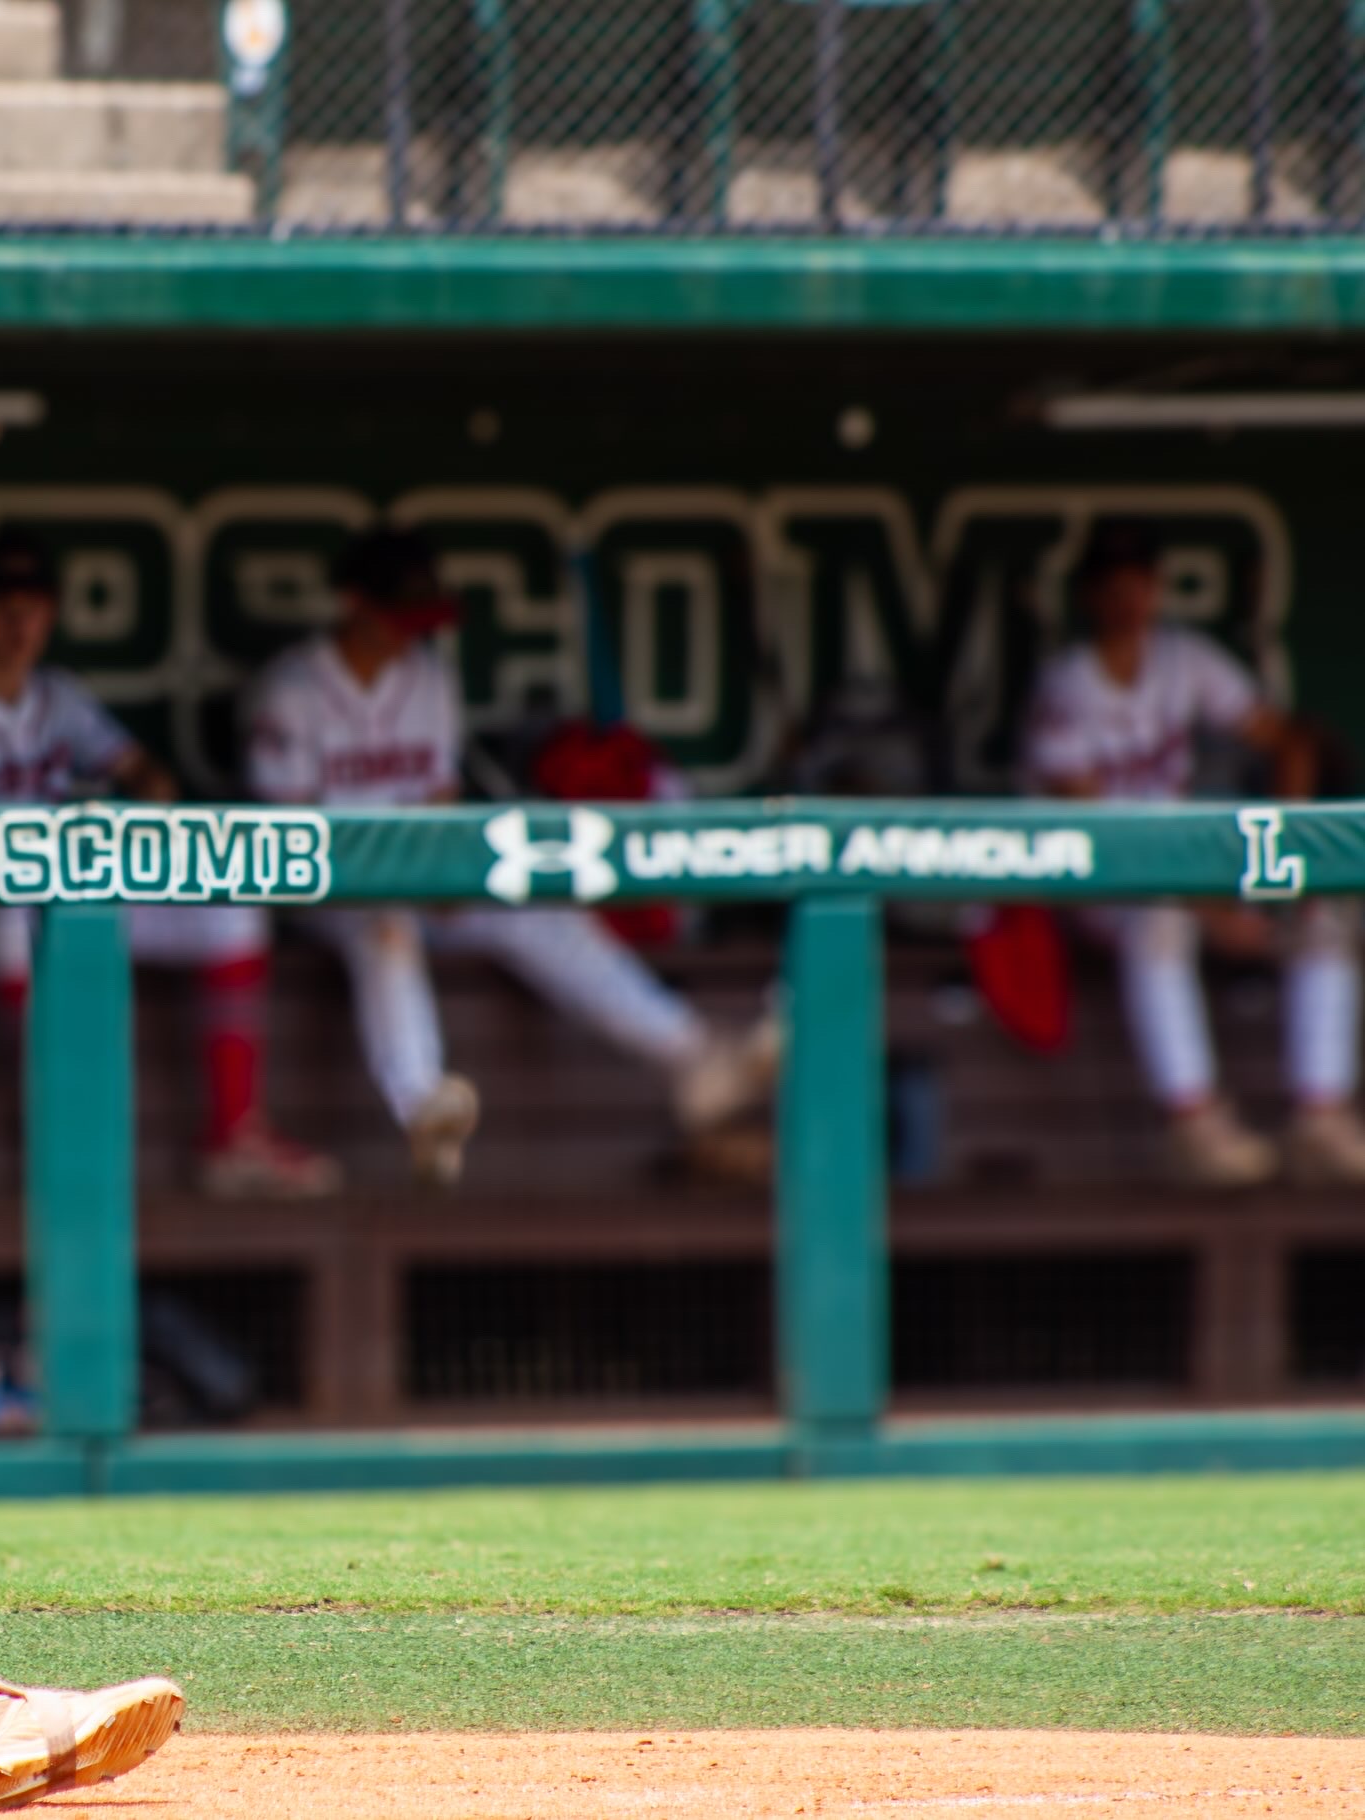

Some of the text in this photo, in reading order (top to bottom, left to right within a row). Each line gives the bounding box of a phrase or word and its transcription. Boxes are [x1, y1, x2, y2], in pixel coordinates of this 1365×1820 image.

[625, 822, 1093, 879] UNDER ARMOUR
[1237, 807, 1305, 900] L
